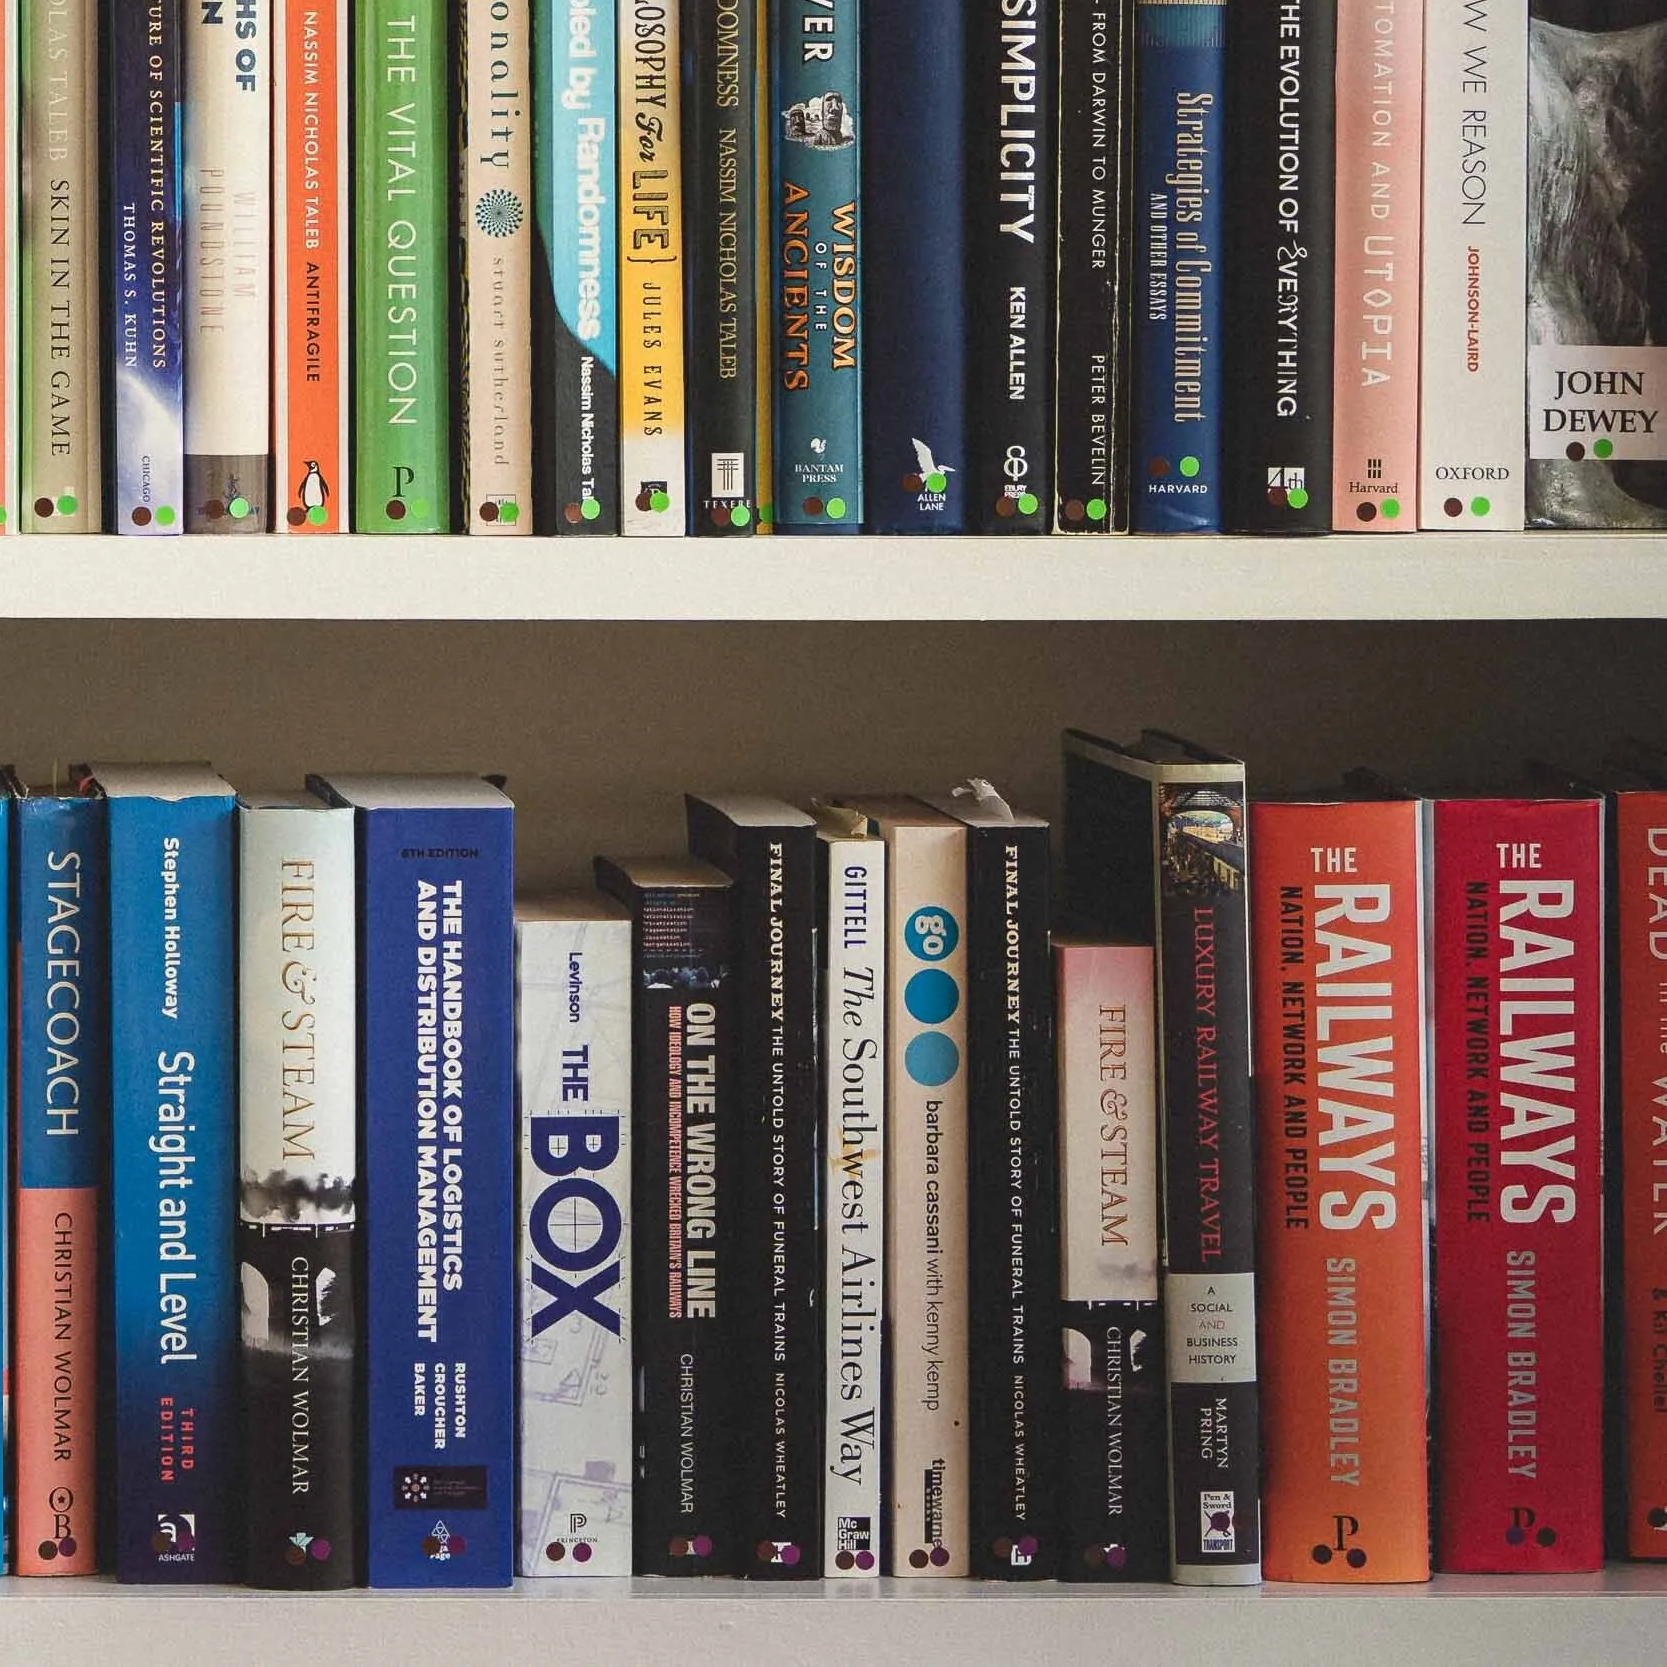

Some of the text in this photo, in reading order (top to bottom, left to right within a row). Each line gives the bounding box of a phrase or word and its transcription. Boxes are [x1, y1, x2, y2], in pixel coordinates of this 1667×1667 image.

[236, 49, 256, 91] OF
[1463, 46, 1487, 93] WE
[1462, 110, 1487, 224] REASON
[388, 15, 417, 423] THE VITAL QUESTION
[1555, 371, 1645, 399] JOHN
[1149, 485, 1208, 494] HARVARD
[1436, 467, 1509, 480] OXFORD
[1311, 847, 1357, 872] THE
[844, 866, 864, 949] GITTELL
[47, 851, 80, 1135] STAGECOACH
[568, 952, 583, 1023] Levinson
[442, 880, 463, 1291] THE HANDBOOK OF LOGISTICS
[1315, 884, 1396, 1229] RAILWAYS
[149, 1051, 197, 1364] Straight and Level
[529, 1045, 622, 1338] THE BOX
[1191, 1303, 1232, 1313] SOCIAL
[1188, 1355, 1235, 1364] HISTORY
